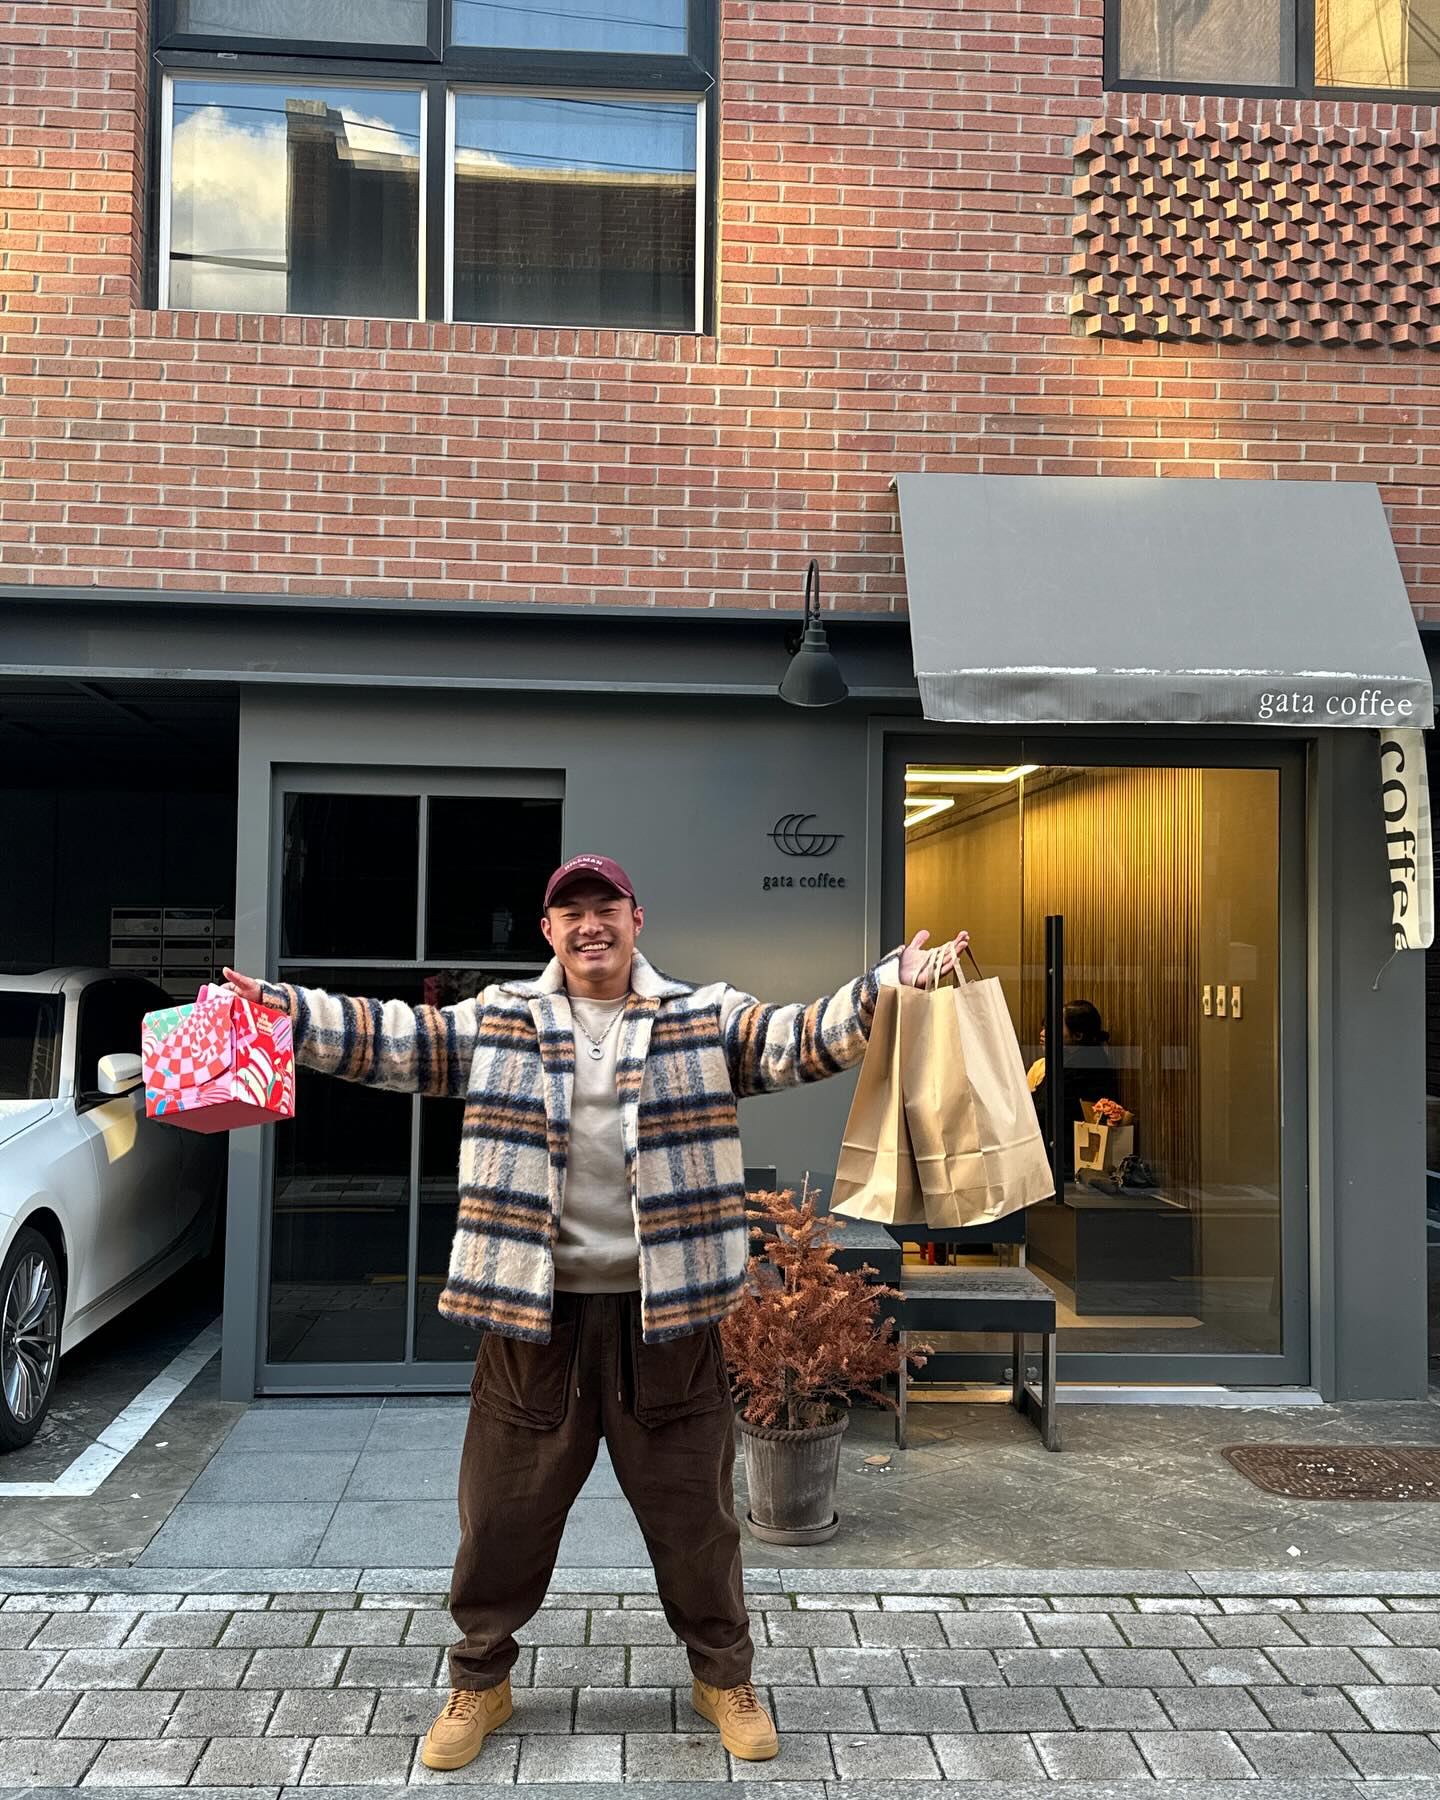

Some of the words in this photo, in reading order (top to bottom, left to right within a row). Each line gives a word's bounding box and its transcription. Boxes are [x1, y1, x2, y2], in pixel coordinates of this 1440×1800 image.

[1258, 691, 1314, 719] gata
[1326, 689, 1413, 716] coffee
[762, 876, 794, 891] gata
[799, 872, 846, 888] coffee
